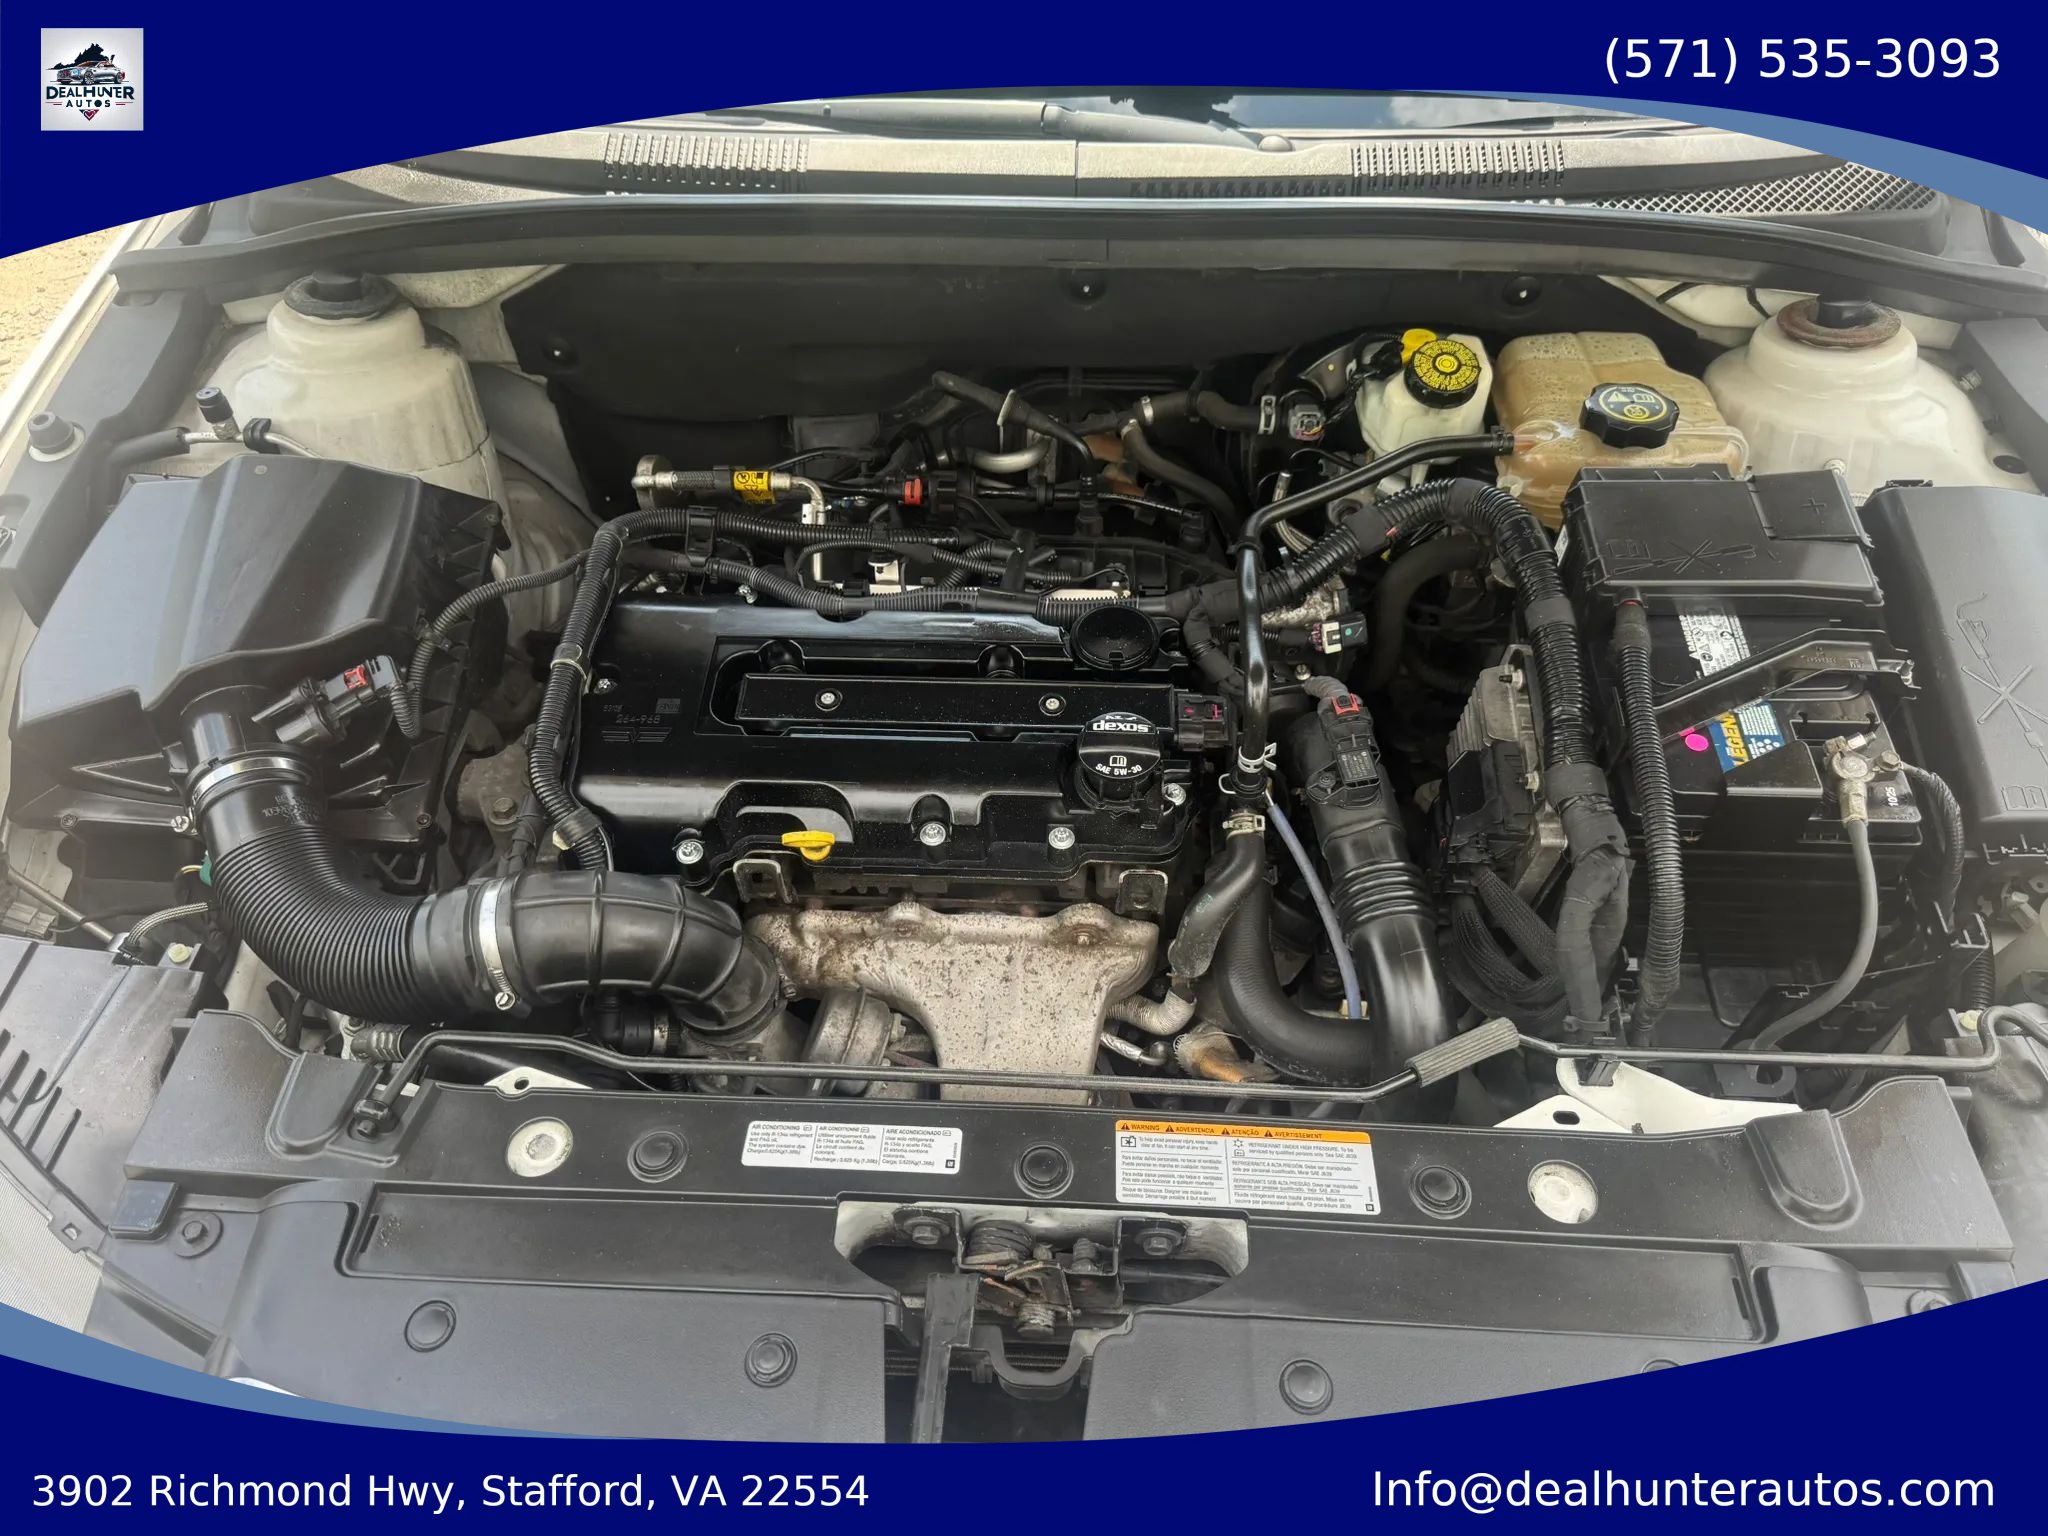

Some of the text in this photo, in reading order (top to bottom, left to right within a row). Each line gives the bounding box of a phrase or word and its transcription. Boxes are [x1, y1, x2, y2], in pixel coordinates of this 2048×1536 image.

[1092, 719, 1150, 733] dexos
[1095, 763, 1143, 776] SAE 5W-30
[1176, 1126, 1215, 1134] ADVERTENCIA
[1275, 1131, 1323, 1139] AVERTISSEMENT
